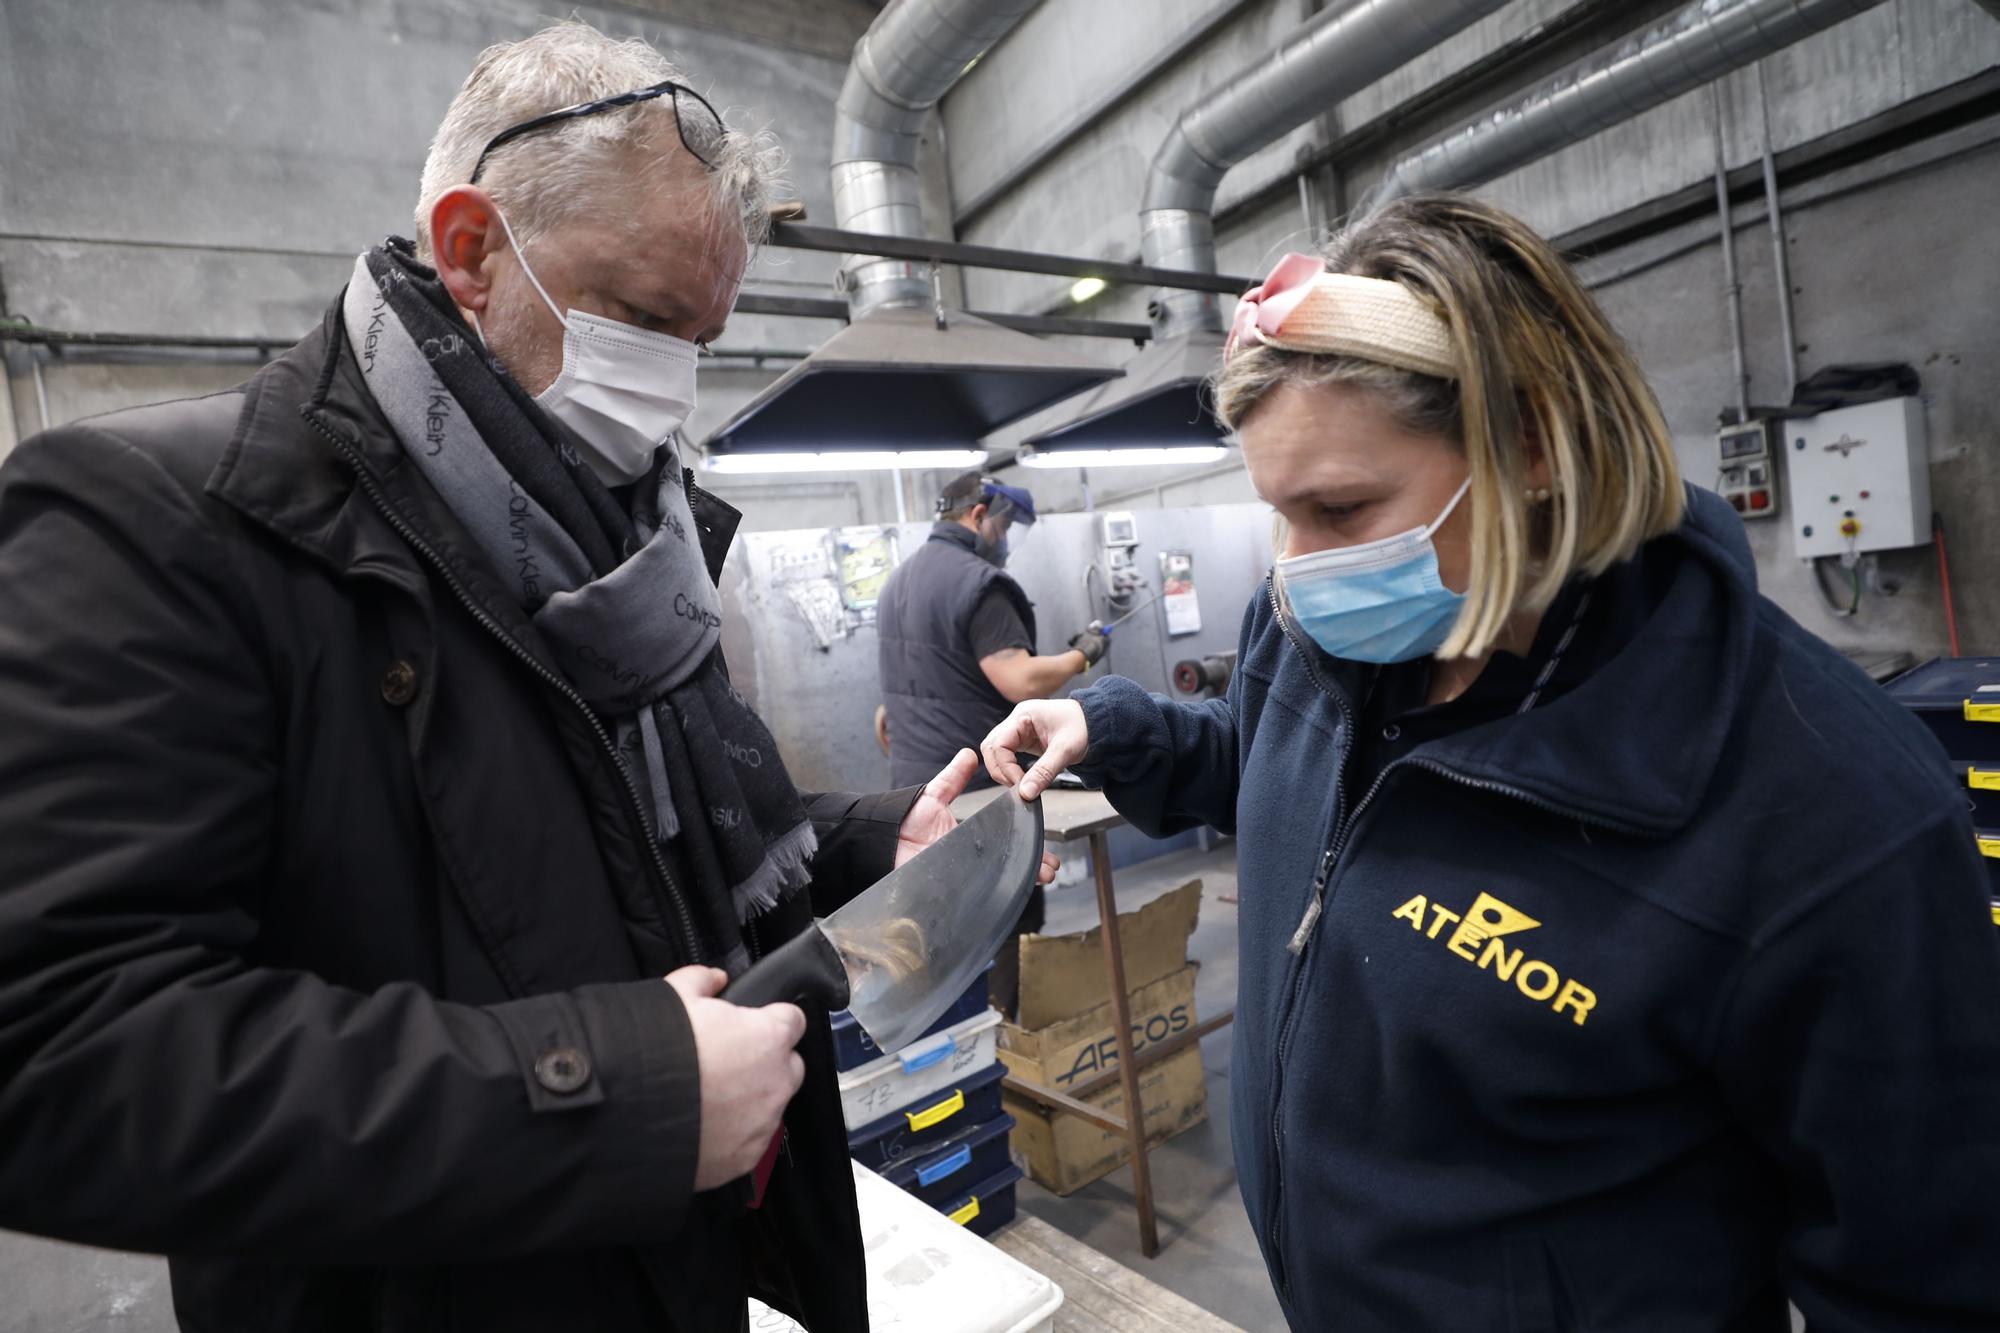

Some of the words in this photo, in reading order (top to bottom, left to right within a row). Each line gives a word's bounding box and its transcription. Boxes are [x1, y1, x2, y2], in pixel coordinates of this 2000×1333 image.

[364, 312, 386, 374] Klein
[426, 394, 451, 457] Klein
[1392, 894, 1598, 1026] ATENOR
[1055, 1005, 1189, 1084] ARCOS
